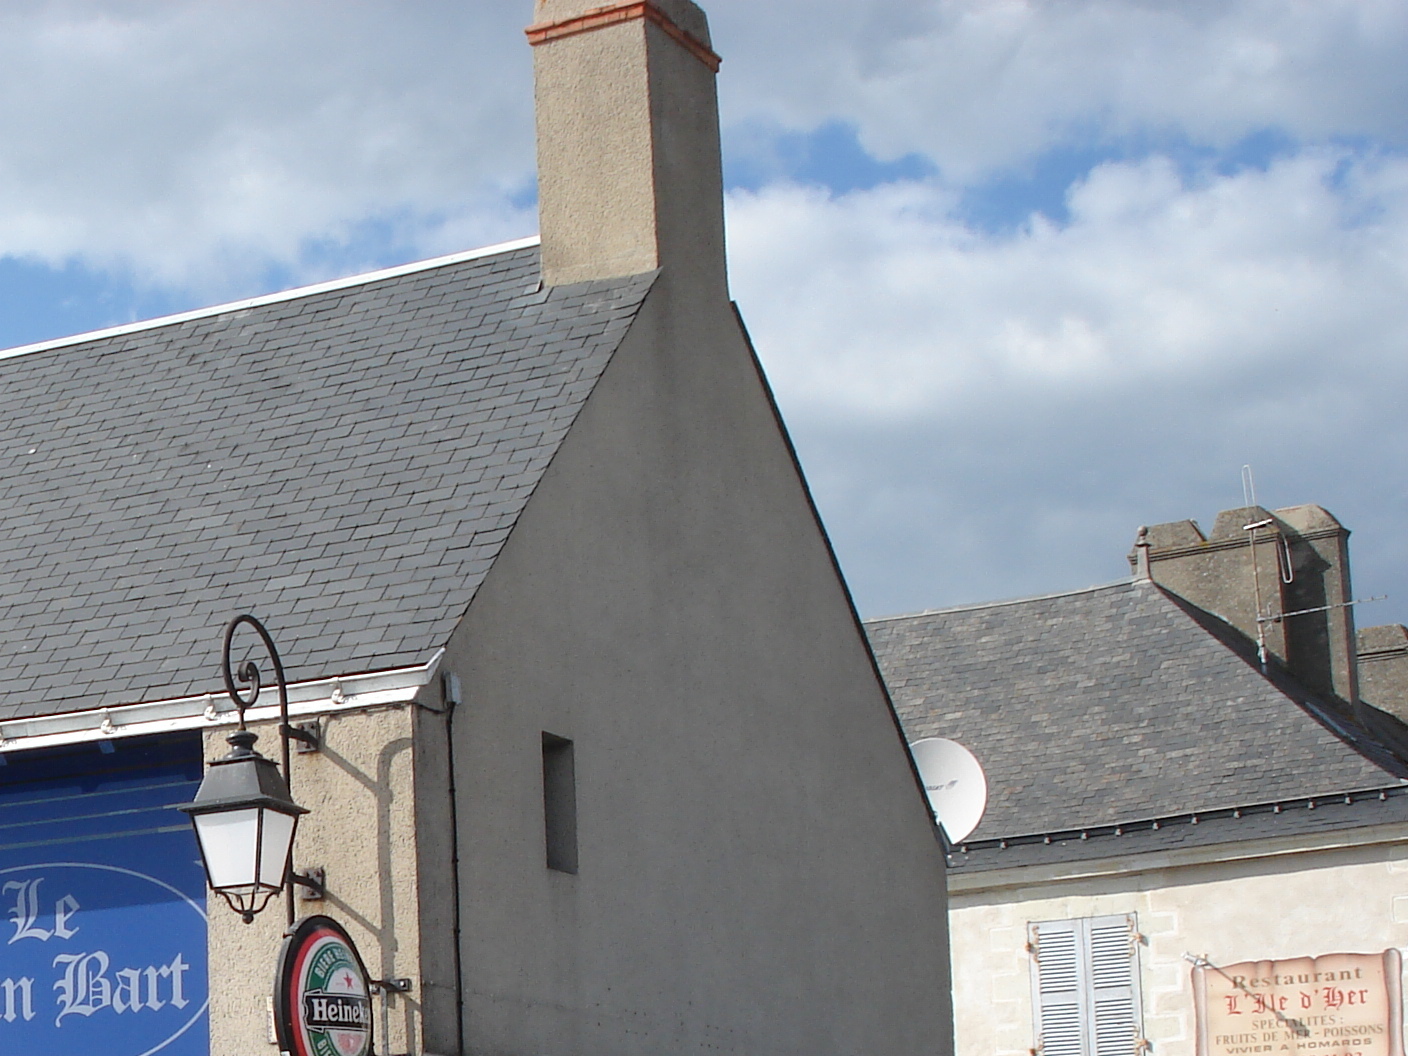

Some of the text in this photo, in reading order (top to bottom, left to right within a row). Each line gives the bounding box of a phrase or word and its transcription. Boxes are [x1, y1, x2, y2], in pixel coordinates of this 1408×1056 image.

[2, 878, 81, 944] Le
[52, 951, 190, 1028] Bart
[1232, 967, 1363, 989] Restaurant
[1300, 987, 1368, 1011] d'Her
[1215, 1031, 1257, 1045] FRUITS
[1263, 1030, 1278, 1042] DE
[1284, 1028, 1310, 1041] MER
[1323, 1023, 1384, 1038] POISSONS
[1226, 1037, 1372, 1054] VIVIER A HOMARDS
